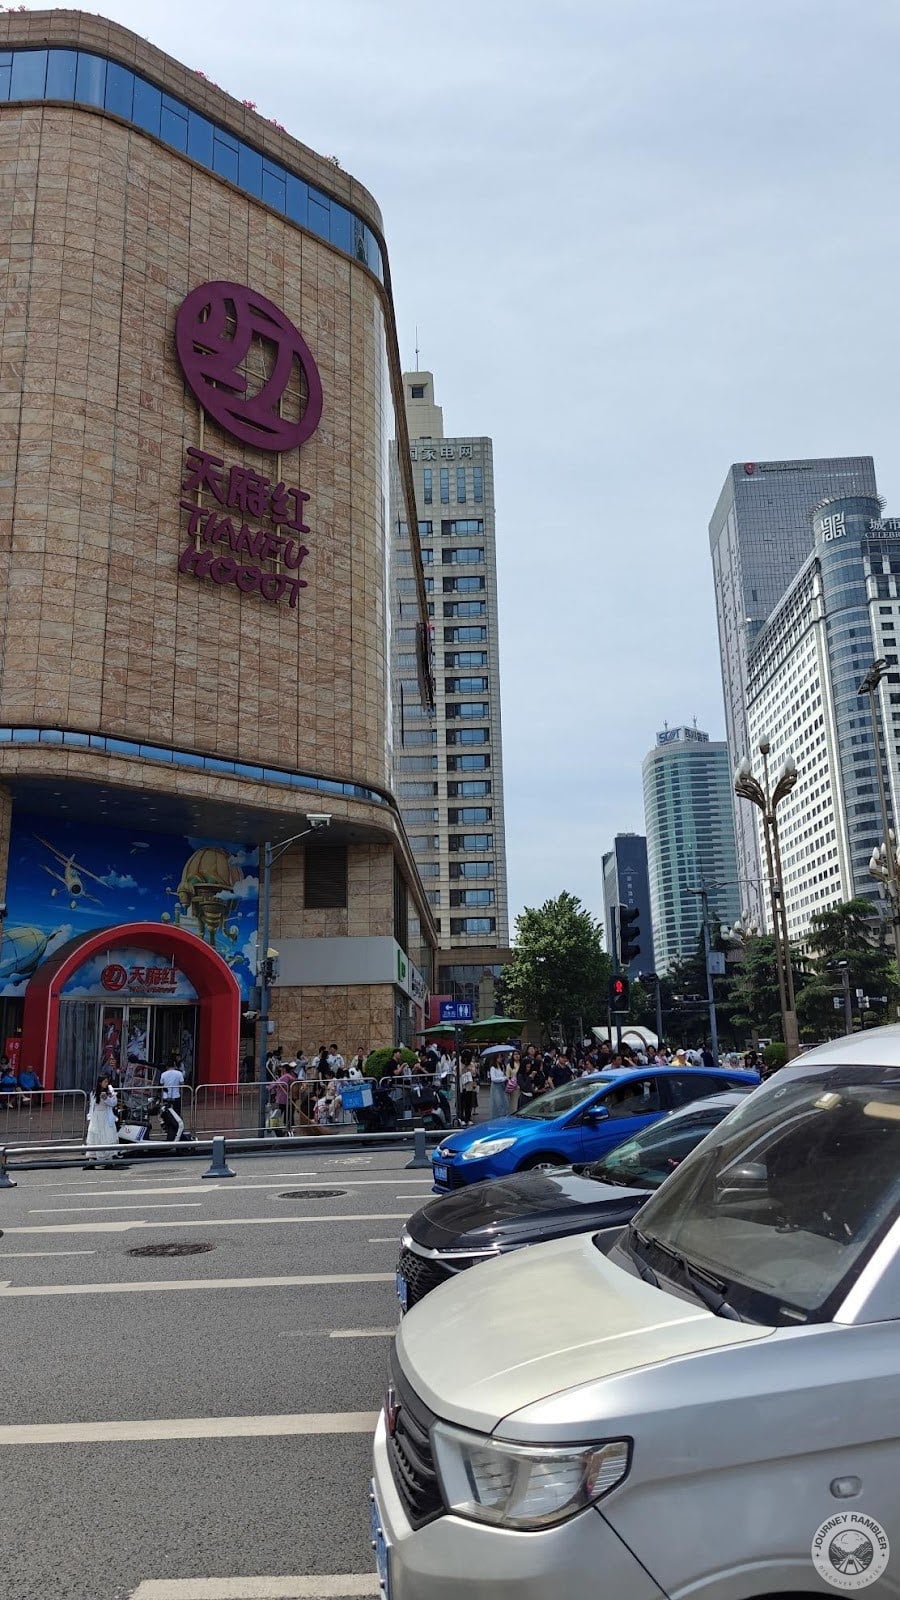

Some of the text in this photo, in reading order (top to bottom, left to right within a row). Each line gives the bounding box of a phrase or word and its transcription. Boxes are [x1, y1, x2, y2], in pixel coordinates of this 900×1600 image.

[181, 446, 311, 533] 天府红
[179, 501, 309, 569] TIANFU
[128, 966, 178, 986] 天府红
